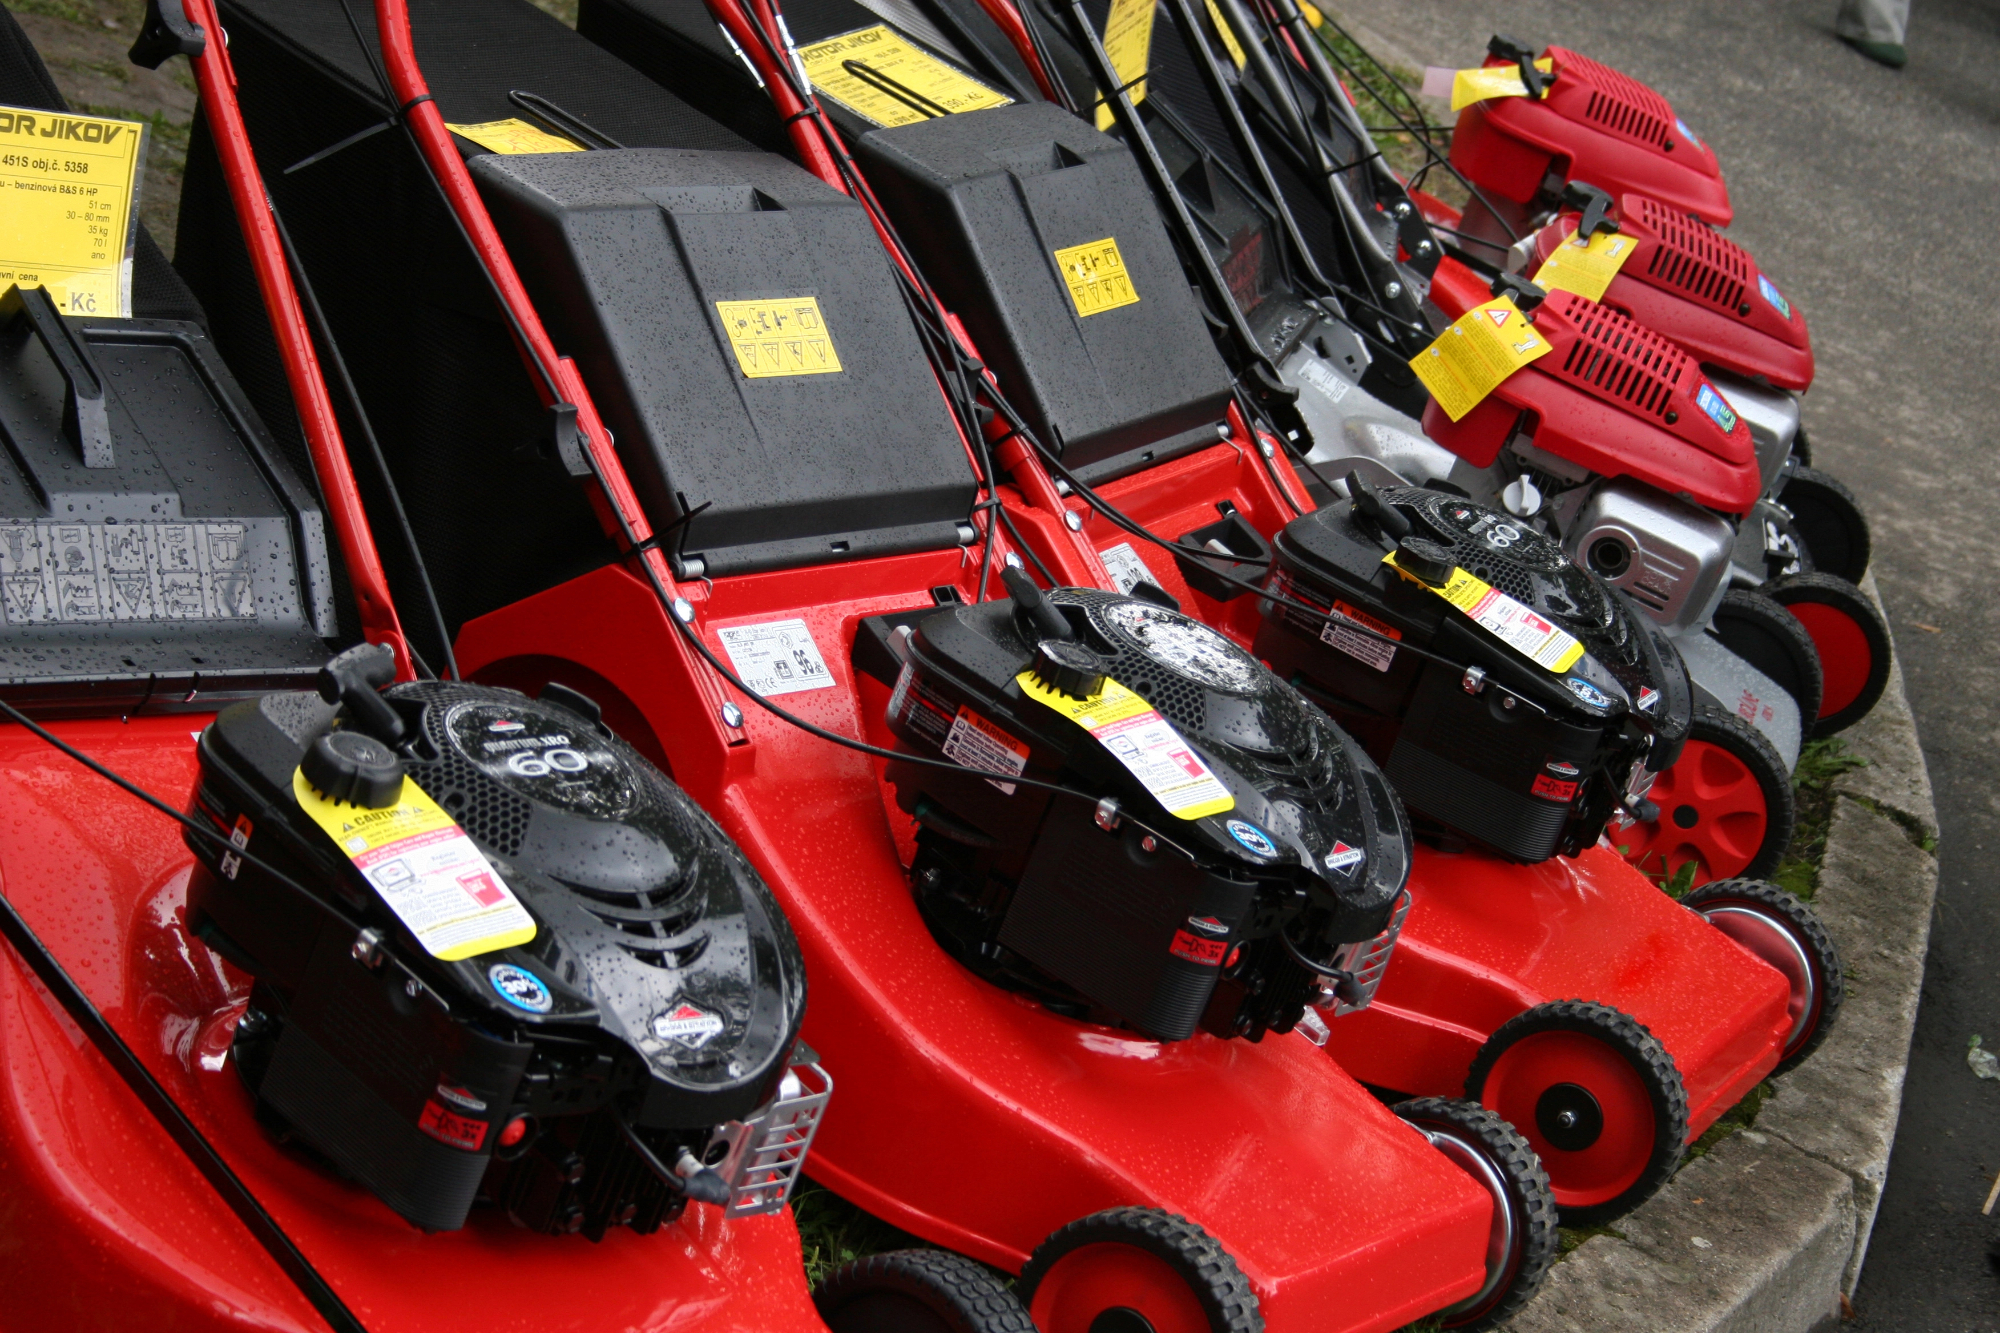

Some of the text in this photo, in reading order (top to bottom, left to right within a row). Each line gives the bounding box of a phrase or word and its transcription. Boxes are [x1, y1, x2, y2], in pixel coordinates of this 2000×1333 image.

[40, 119, 123, 144] JIKOV
[2, 155, 89, 173] 451S obj.č. 5358
[15, 180, 57, 192] benzinová
[60, 185, 77, 195] B&S
[79, 186, 84, 195] 6
[86, 187, 98, 197] HP
[89, 200, 98, 209] 51
[66, 211, 76, 220] 30
[84, 212, 94, 221] 80
[96, 215, 110, 223] mm
[88, 225, 109, 237] 35 kg
[93, 238, 103, 247] 70
[91, 252, 106, 260] ano
[18, 273, 39, 281] cena
[71, 292, 97, 313] Kč
[1486, 524, 1521, 548] 60
[1351, 609, 1391, 636] WARNING
[792, 649, 815, 676] 96
[976, 718, 1018, 750] WARNING
[509, 749, 588, 777] 60
[354, 809, 411, 826] CAUTION
